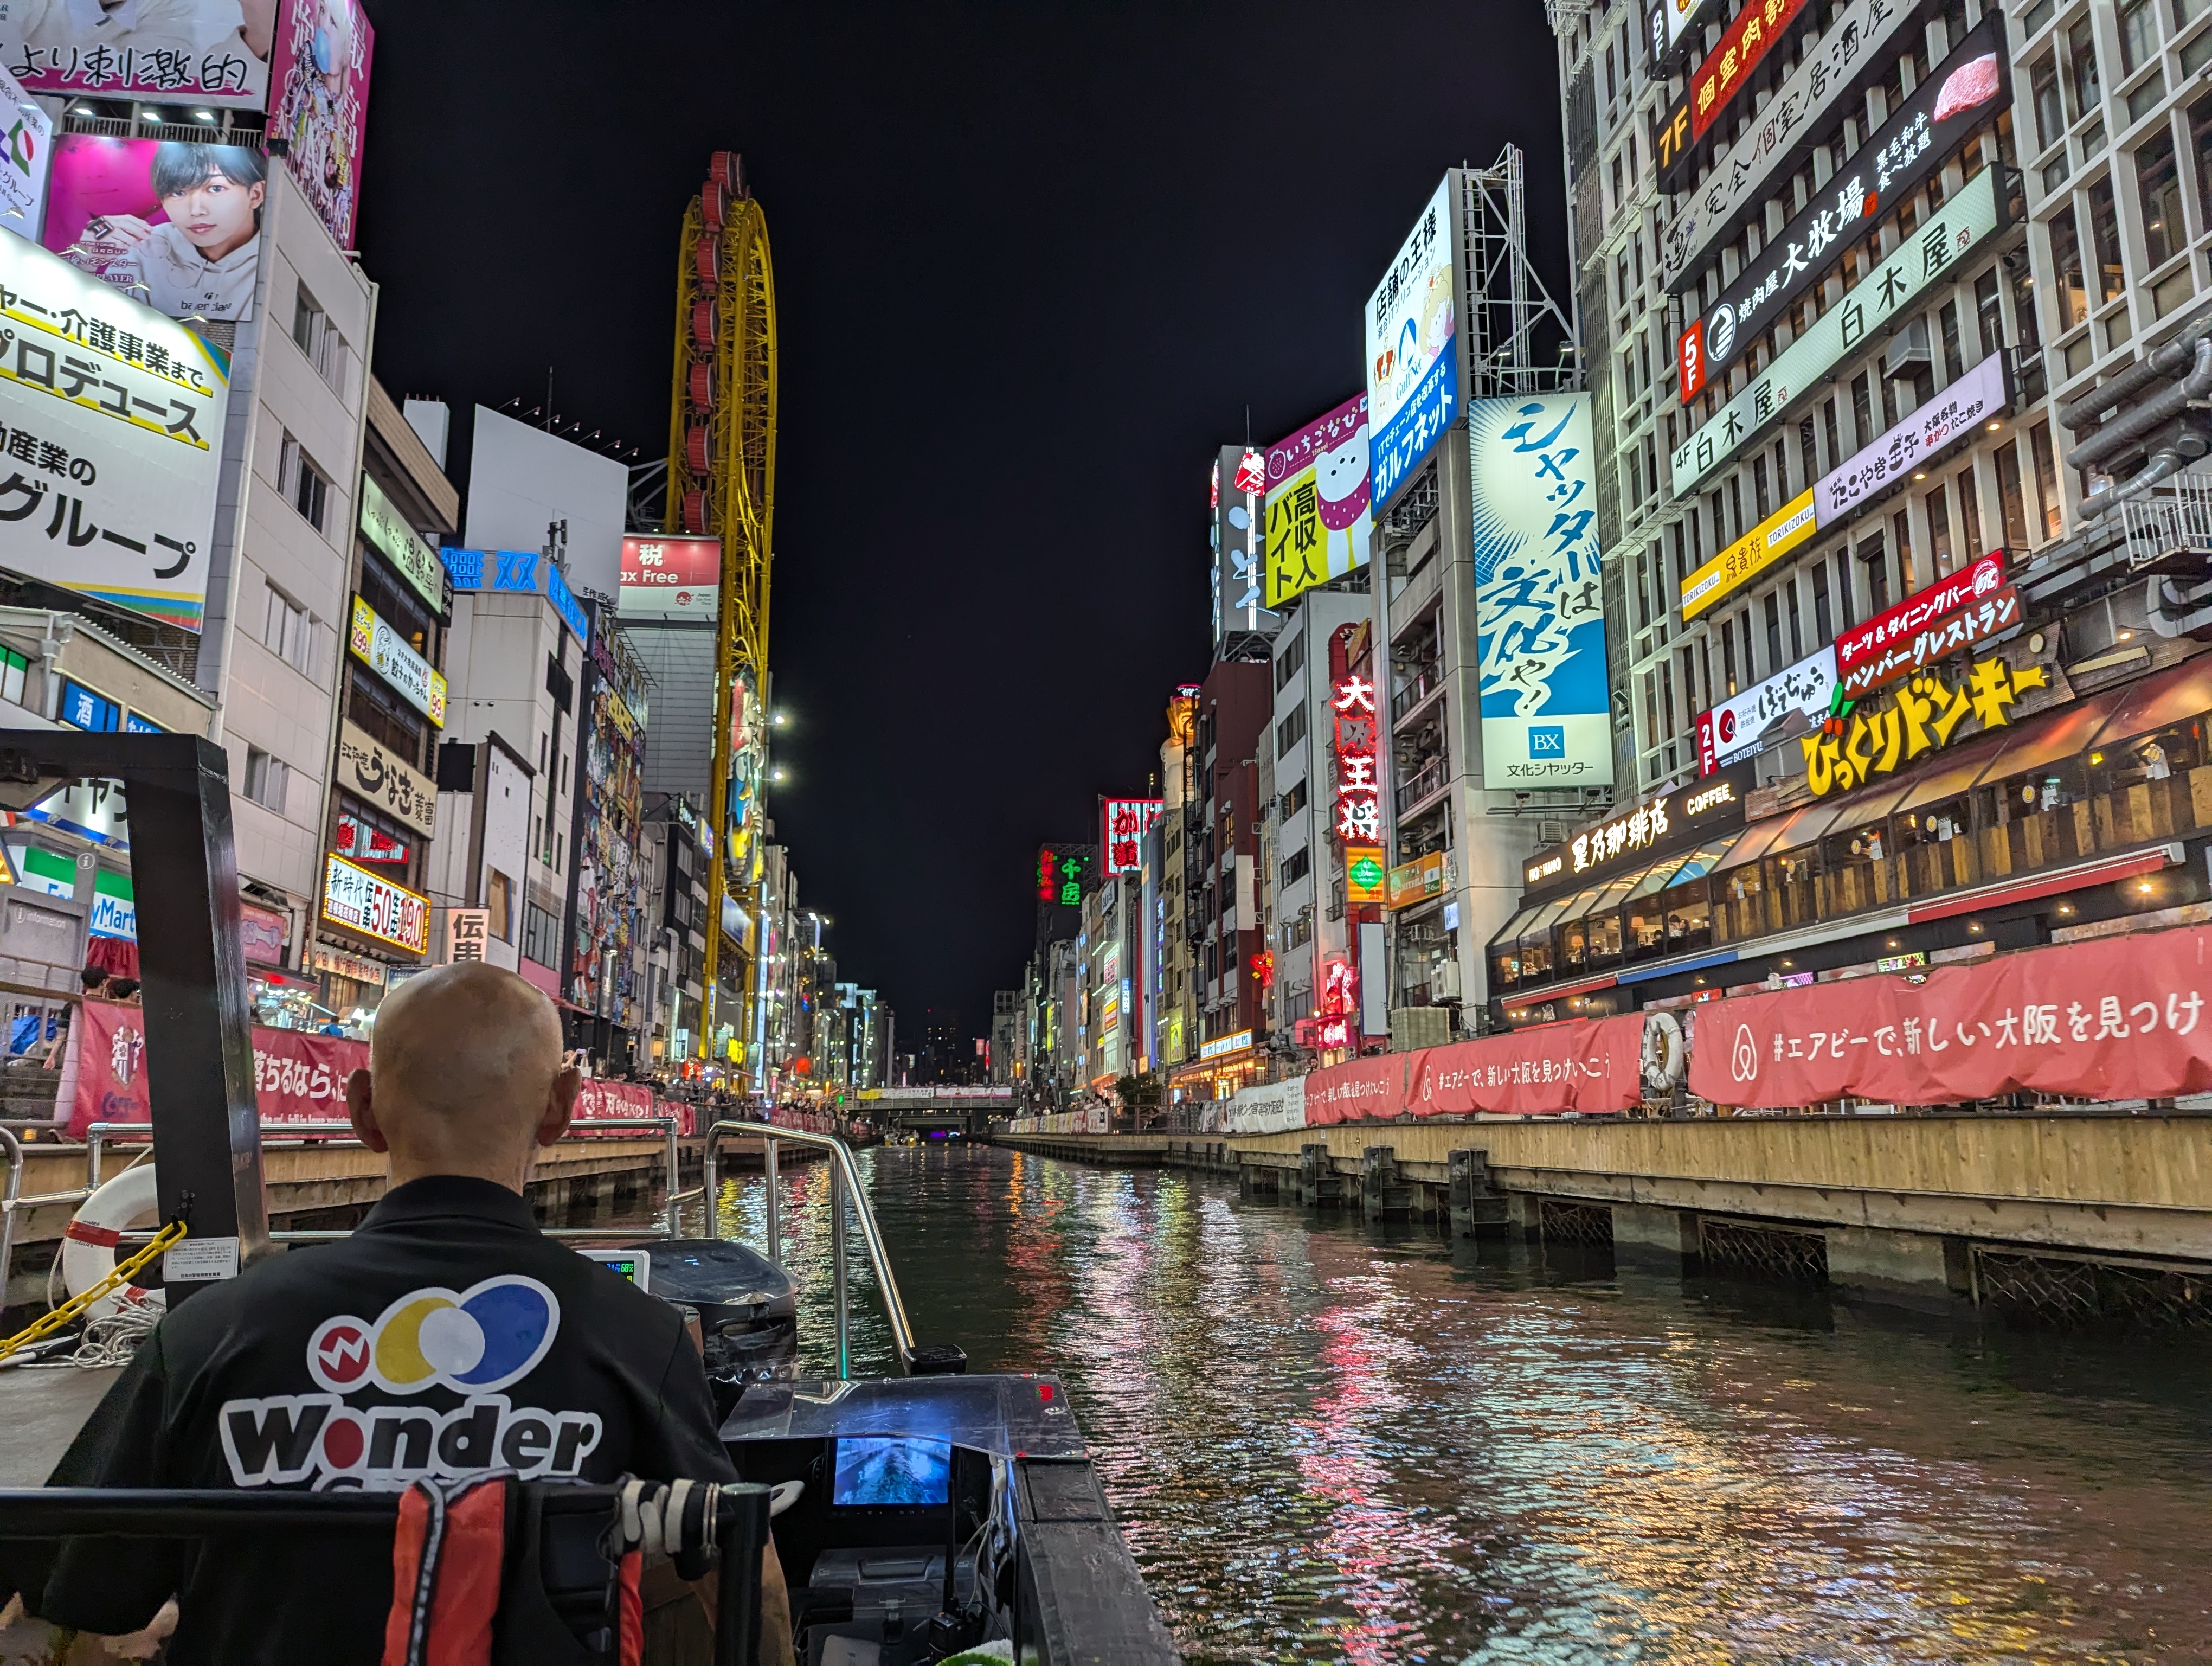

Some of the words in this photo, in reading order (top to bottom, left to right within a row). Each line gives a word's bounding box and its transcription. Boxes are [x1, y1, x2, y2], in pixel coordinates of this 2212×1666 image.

[1653, 9, 1663, 61] 8F
[9, 44, 247, 91] より刺激的
[1660, 105, 1687, 168] 7F
[1705, 0, 1894, 227] 完全個室居酒屋
[1876, 111, 1928, 172] 黒毛和牛
[1878, 127, 1932, 193] 食べ放題
[0, 169, 35, 206] グループ
[1782, 176, 1865, 289] 大牧場
[1377, 206, 1436, 326] 店舗の王様
[1842, 221, 1952, 350] 白木屋
[1739, 270, 1778, 324] 焼肉屋
[1396, 369, 1411, 400] Gulf
[1410, 358, 1422, 381] Net
[1684, 334, 1697, 392] 5F
[1287, 406, 1358, 462] いちごなび
[1378, 361, 1446, 459] ITでチェーン店を改革する
[1676, 448, 1690, 469] 4F
[1697, 378, 1776, 475] 白木屋
[1924, 401, 1957, 434] 大阪名物
[1925, 423, 1949, 447] 串かつ
[1951, 399, 1984, 430] たこ焼き
[1311, 442, 1328, 457] 15navi
[1375, 383, 1452, 503] ガルフネット
[1832, 431, 1919, 510] たこやき王子
[0, 471, 196, 580] グループ
[1294, 480, 1317, 589] 高収入
[1501, 399, 1602, 621] シャッターは
[1769, 509, 1810, 544] TORIKIZOKU
[639, 544, 663, 566] 税
[1270, 496, 1293, 599] バイト
[1726, 536, 1762, 583] 鳥貴族
[620, 572, 637, 582] ax
[642, 569, 678, 584] Free
[1683, 575, 1715, 605] TORIKIZOKU
[1846, 596, 2016, 692] ハンバーグレストラン
[1758, 666, 1824, 721] ぼてぢゅう
[1533, 734, 1561, 751] BX
[1702, 723, 1712, 774] 2F
[1801, 657, 2049, 794] びっくりドンキー
[356, 746, 415, 816] うなぎ
[1572, 798, 1668, 874] 星乃珈琲店
[331, 864, 365, 907] 新時代
[1061, 858, 1081, 901] 千房
[1368, 890, 1382, 899] 2F
[1401, 877, 1424, 889] MITHILA
[1425, 885, 1430, 893] 2F
[1529, 857, 1562, 883] HOSHINO
[371, 883, 391, 935] 50
[397, 897, 424, 947] 190
[453, 913, 483, 962] 伝串
[223, 1399, 600, 1478] Wonder
